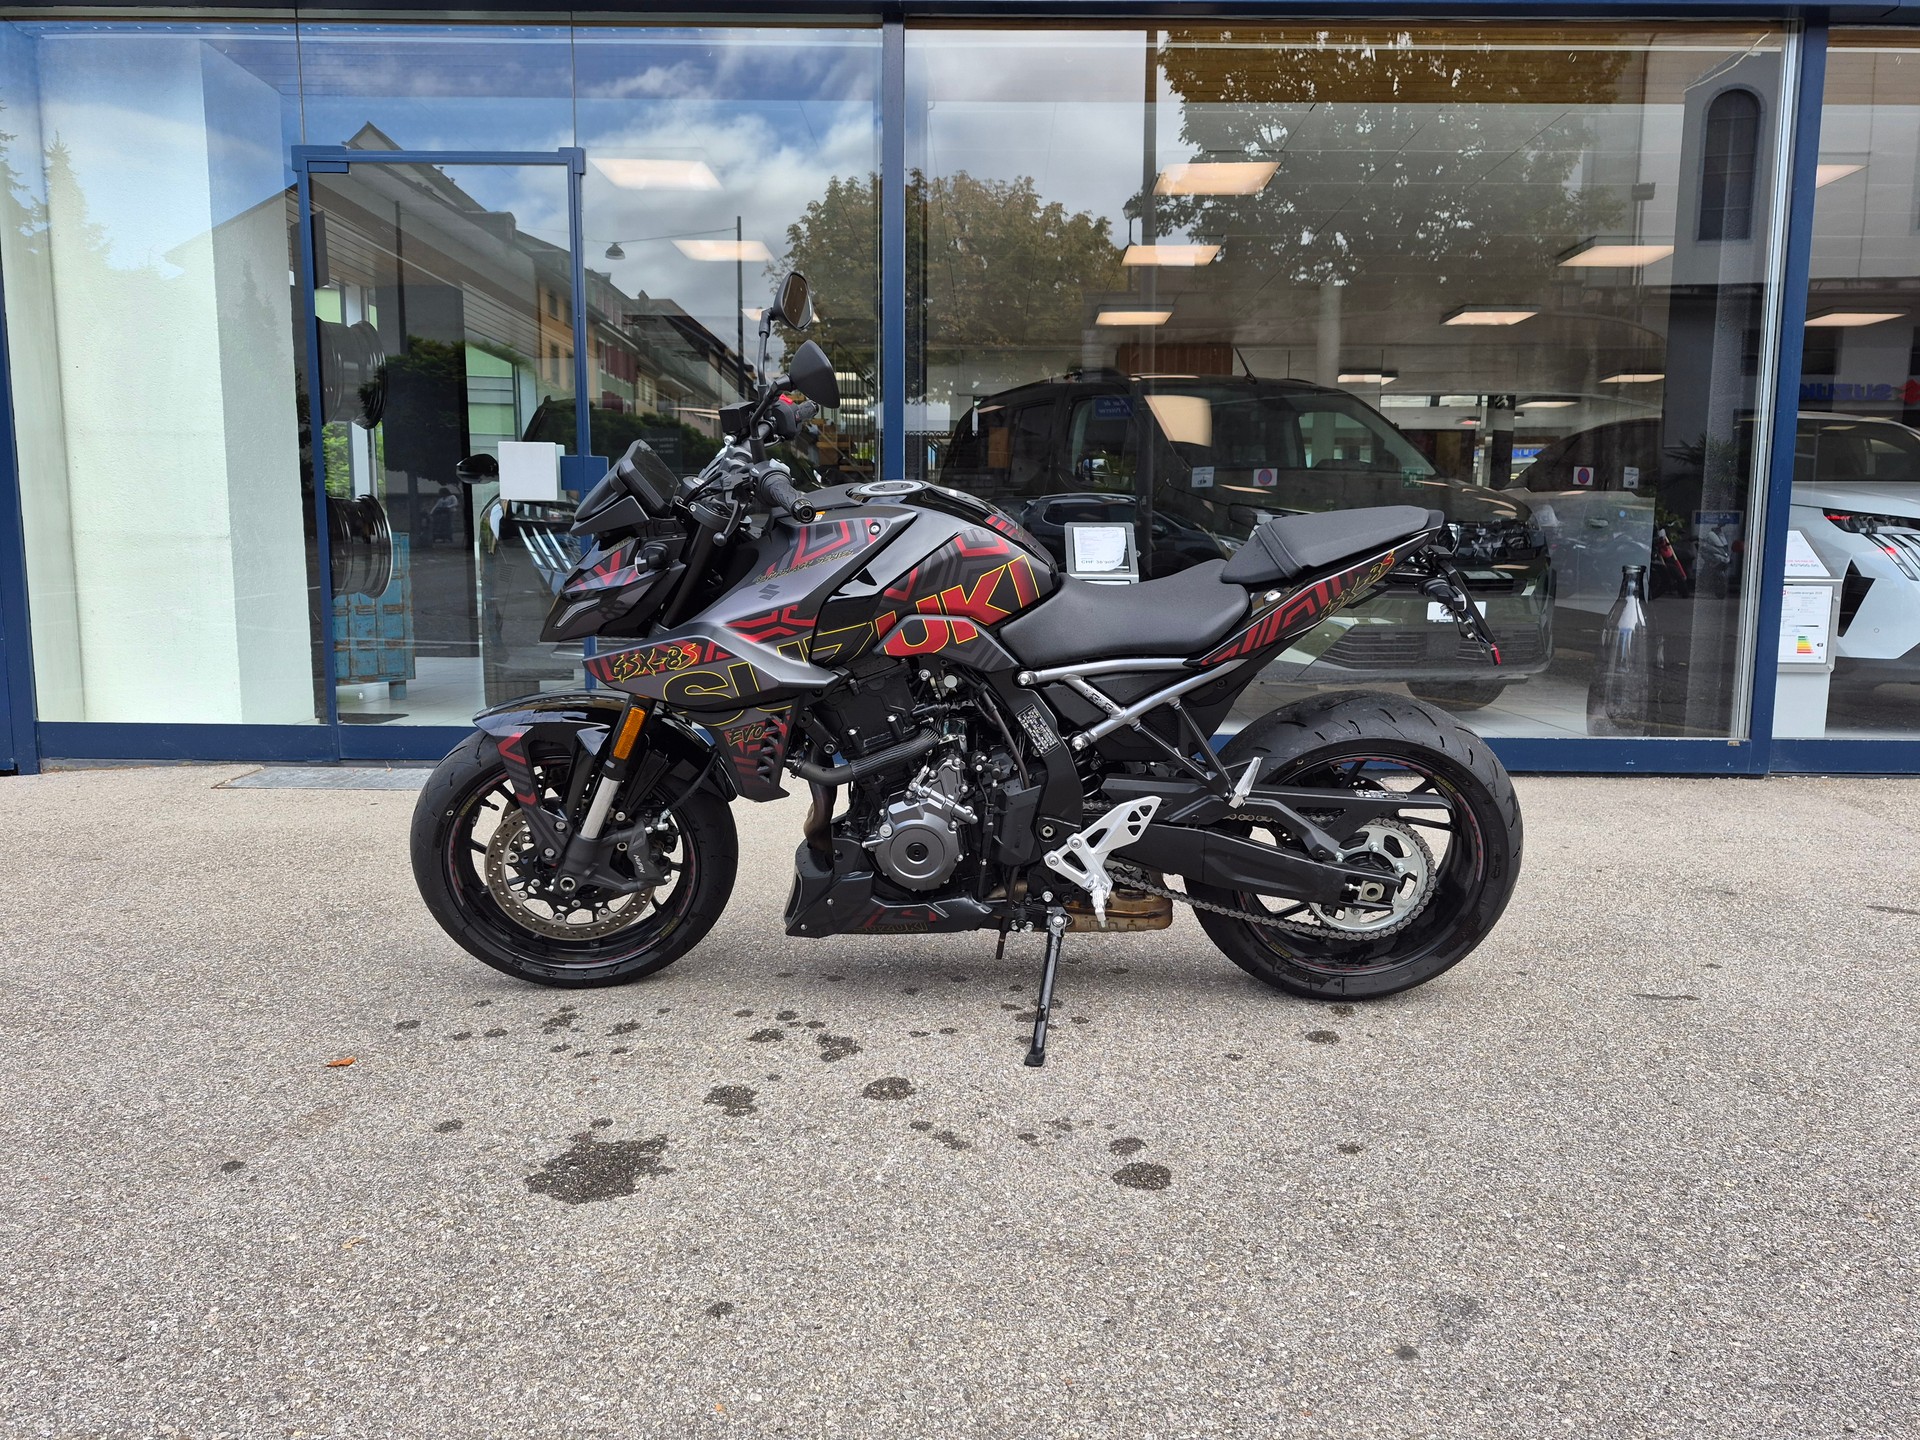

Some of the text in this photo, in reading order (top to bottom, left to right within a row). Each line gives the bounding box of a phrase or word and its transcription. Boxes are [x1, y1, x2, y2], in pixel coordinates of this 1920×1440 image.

[663, 554, 1041, 726] SUZUKI
[612, 642, 699, 684] GSX-8S
[729, 722, 766, 747] EVO
